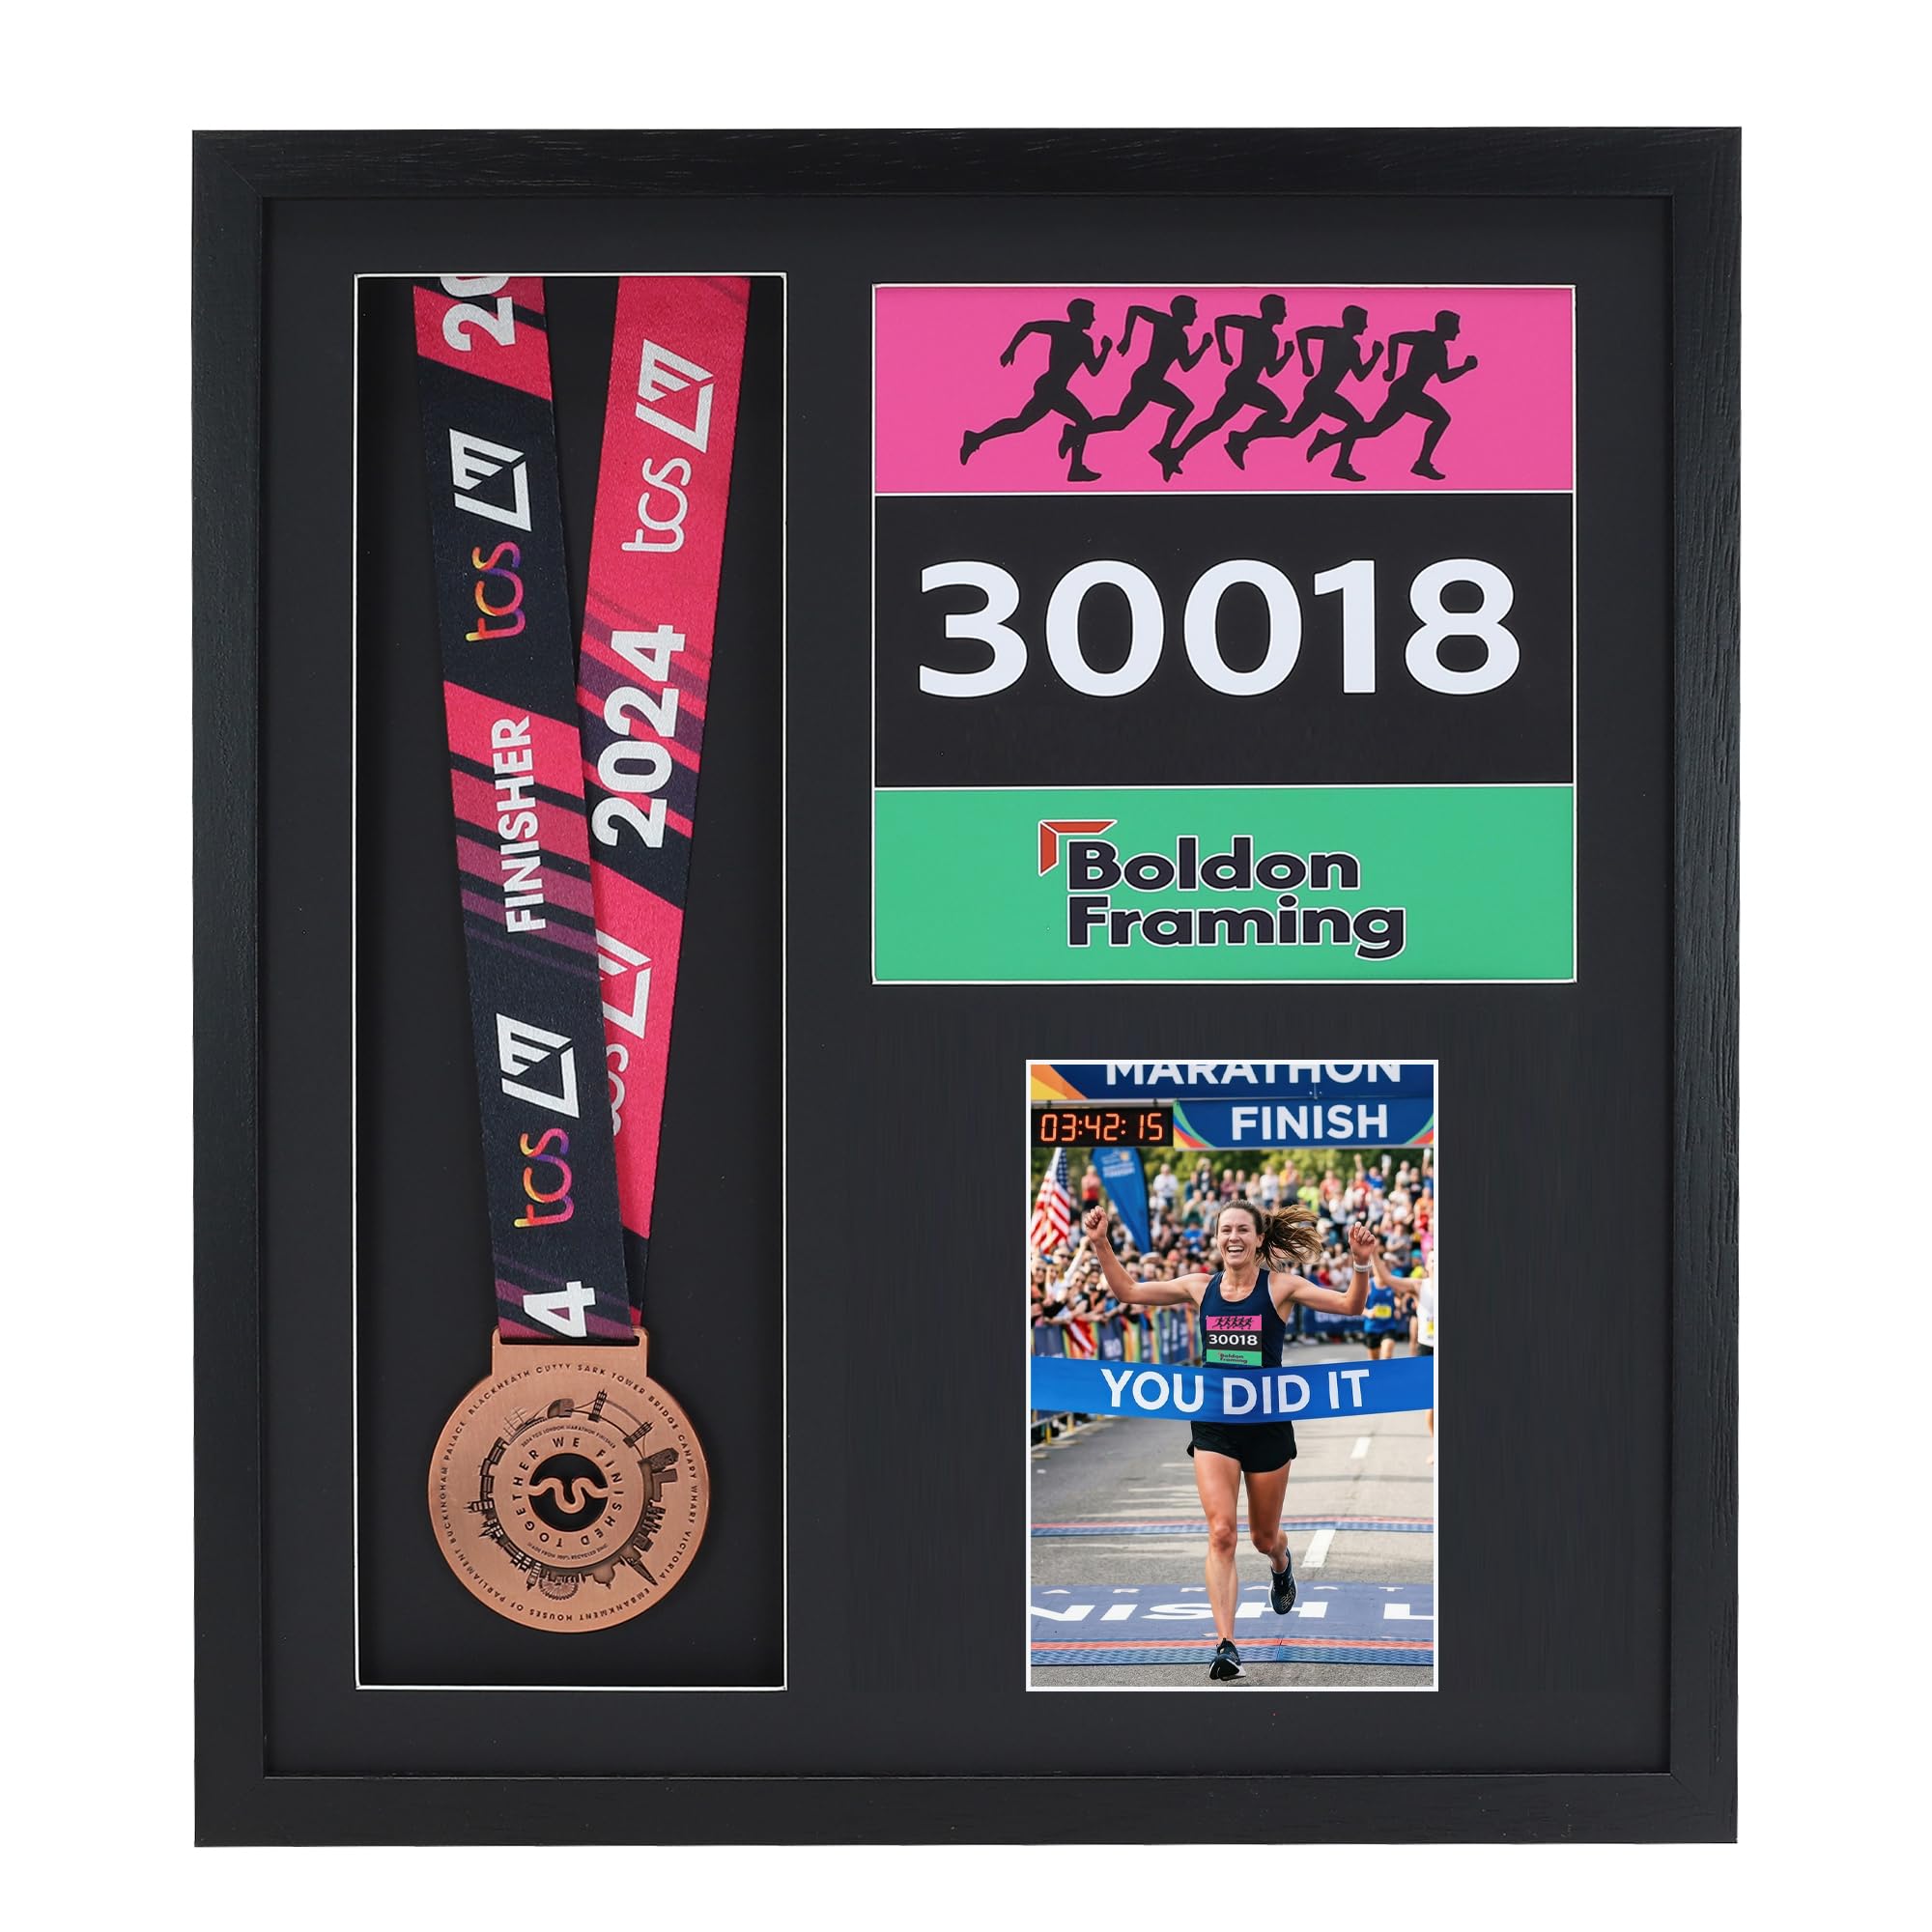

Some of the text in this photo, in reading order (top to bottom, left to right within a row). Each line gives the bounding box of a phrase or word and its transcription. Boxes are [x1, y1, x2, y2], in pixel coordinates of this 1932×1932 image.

[621, 457, 693, 553] tcs
[465, 541, 526, 641] tcs
[919, 558, 1520, 697] 30018
[591, 624, 686, 849] 2024
[491, 716, 547, 933] FINISHER
[1066, 836, 1361, 893] Boldon
[1066, 895, 1406, 958] Framing
[1106, 1063, 1401, 1086] MARATHON
[1232, 1104, 1388, 1140] FINISH
[514, 1127, 575, 1228] tcs
[1208, 1334, 1258, 1346] 30018
[577, 1362, 607, 1376] SARK
[611, 1370, 647, 1395] TOWER
[1100, 1368, 1370, 1415] YOU DID IT
[468, 1370, 530, 1415] BLACKHEATH
[647, 1393, 680, 1430] BRIDGE
[443, 1419, 468, 1461] PALACE
[677, 1433, 697, 1479] CANARY
[439, 1465, 457, 1544] BUCKINGHAM
[512, 1435, 624, 1548] WE FINISHED TOGETHER
[686, 1485, 698, 1524] WHARF
[456, 1548, 506, 1602] PARLIAMENT
[657, 1529, 692, 1580] VICTORIA
[508, 1600, 525, 1612] OF
[527, 1607, 572, 1621] HOUSES
[578, 1586, 650, 1621] EMBANKMENT
